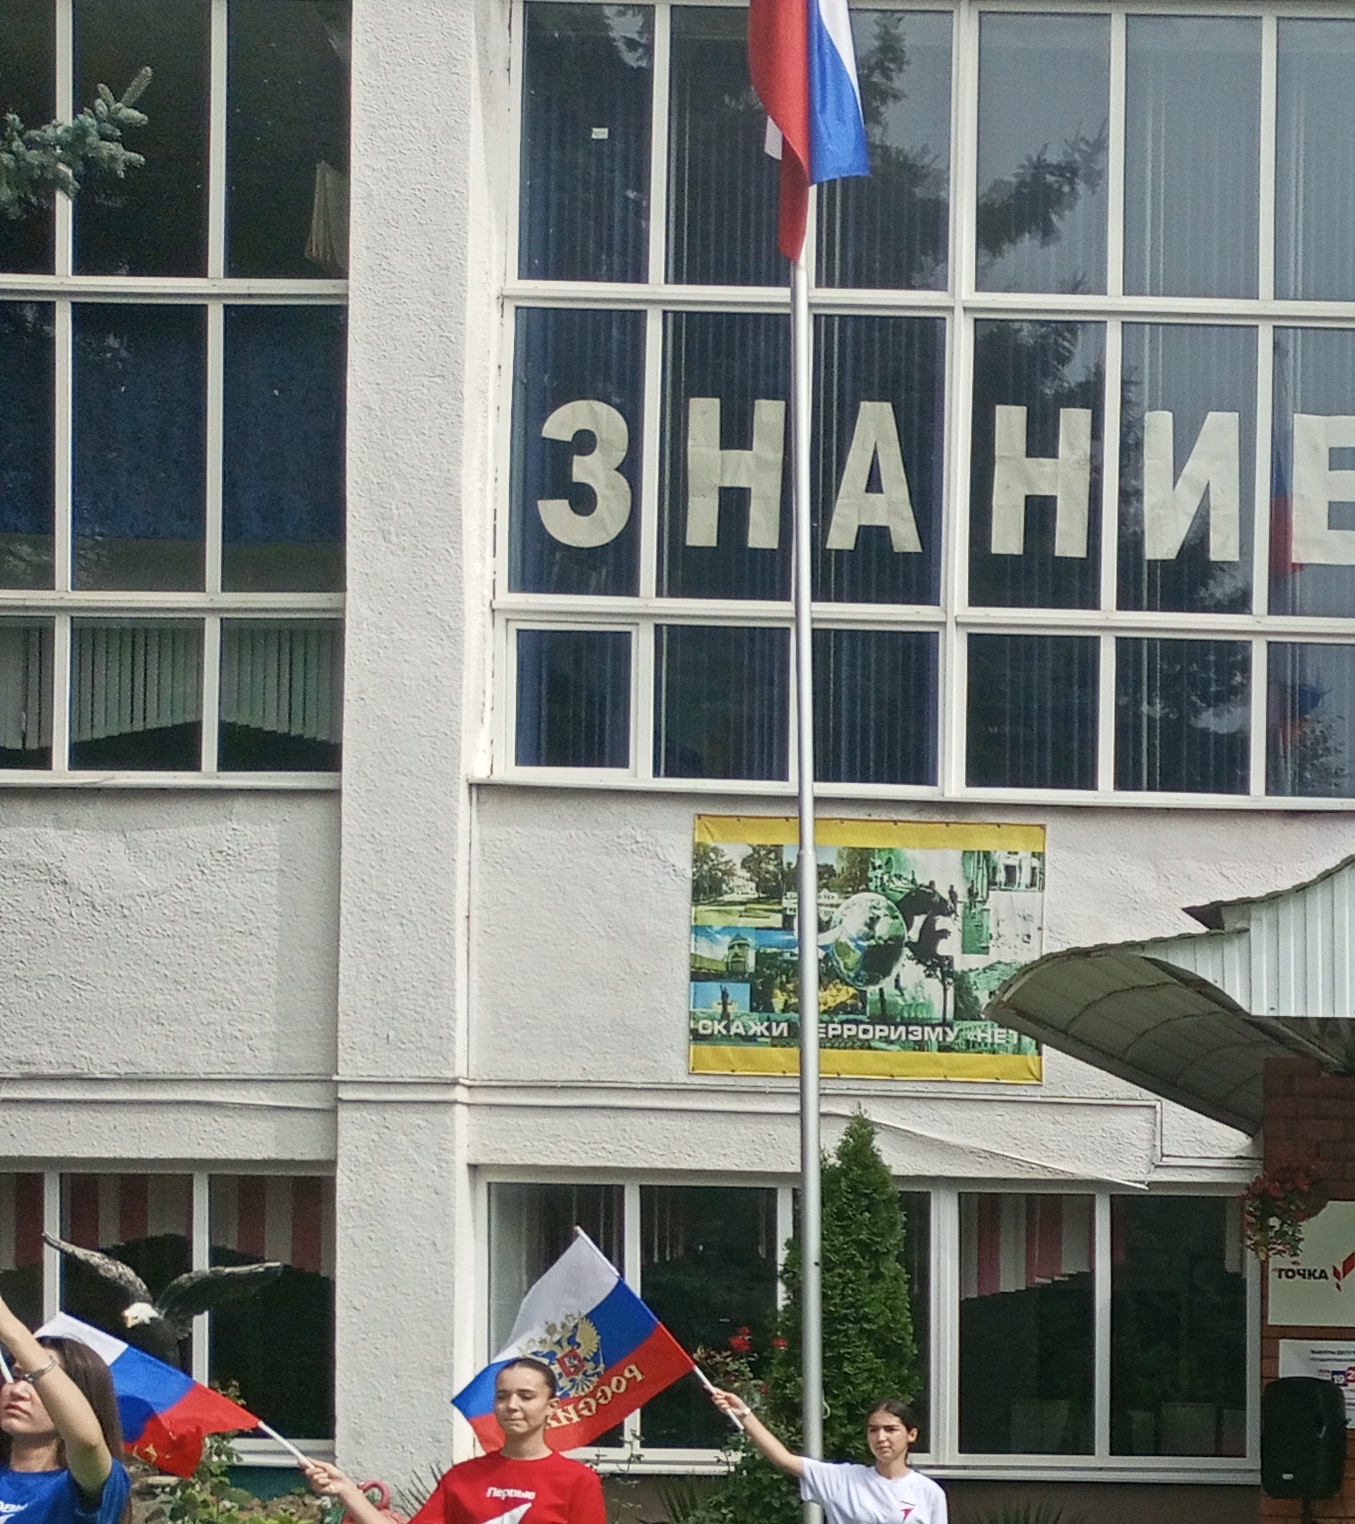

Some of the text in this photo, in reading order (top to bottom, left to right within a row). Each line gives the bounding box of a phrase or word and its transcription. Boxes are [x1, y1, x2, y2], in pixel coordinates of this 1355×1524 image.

[698, 1019, 788, 1037] СКАЖИ
[818, 1022, 957, 1042] ЕРРОРИЗМУ
[1277, 1268, 1329, 1280] ТОЧКА
[1333, 1374, 1345, 1384] 19
